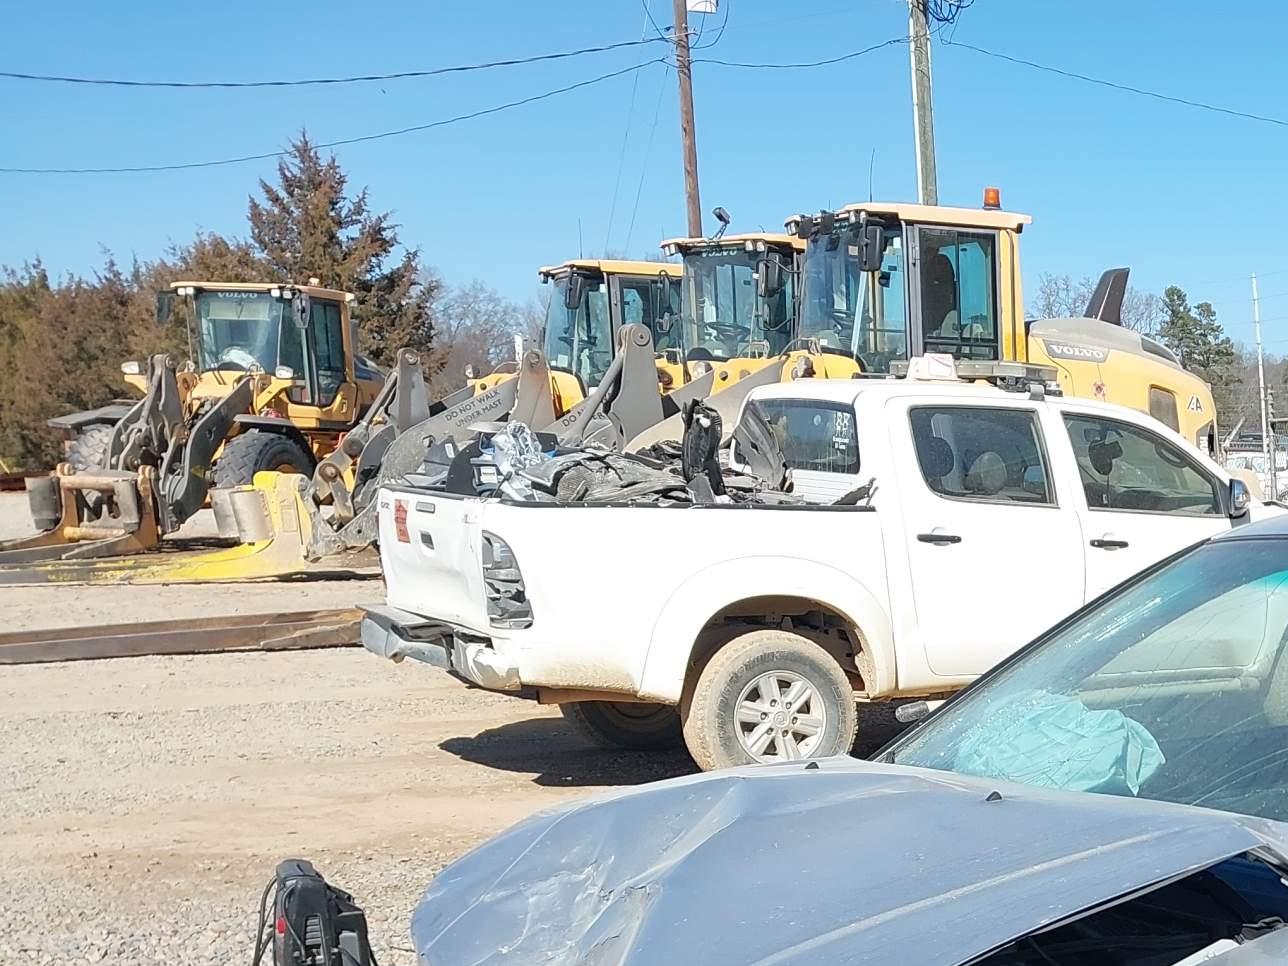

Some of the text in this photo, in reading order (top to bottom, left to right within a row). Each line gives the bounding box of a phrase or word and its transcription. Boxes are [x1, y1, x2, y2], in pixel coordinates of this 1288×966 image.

[1049, 344, 1104, 359] VOLVO
[445, 389, 501, 421] DO NOT WALK
[455, 398, 503, 427] UNDER MAST
